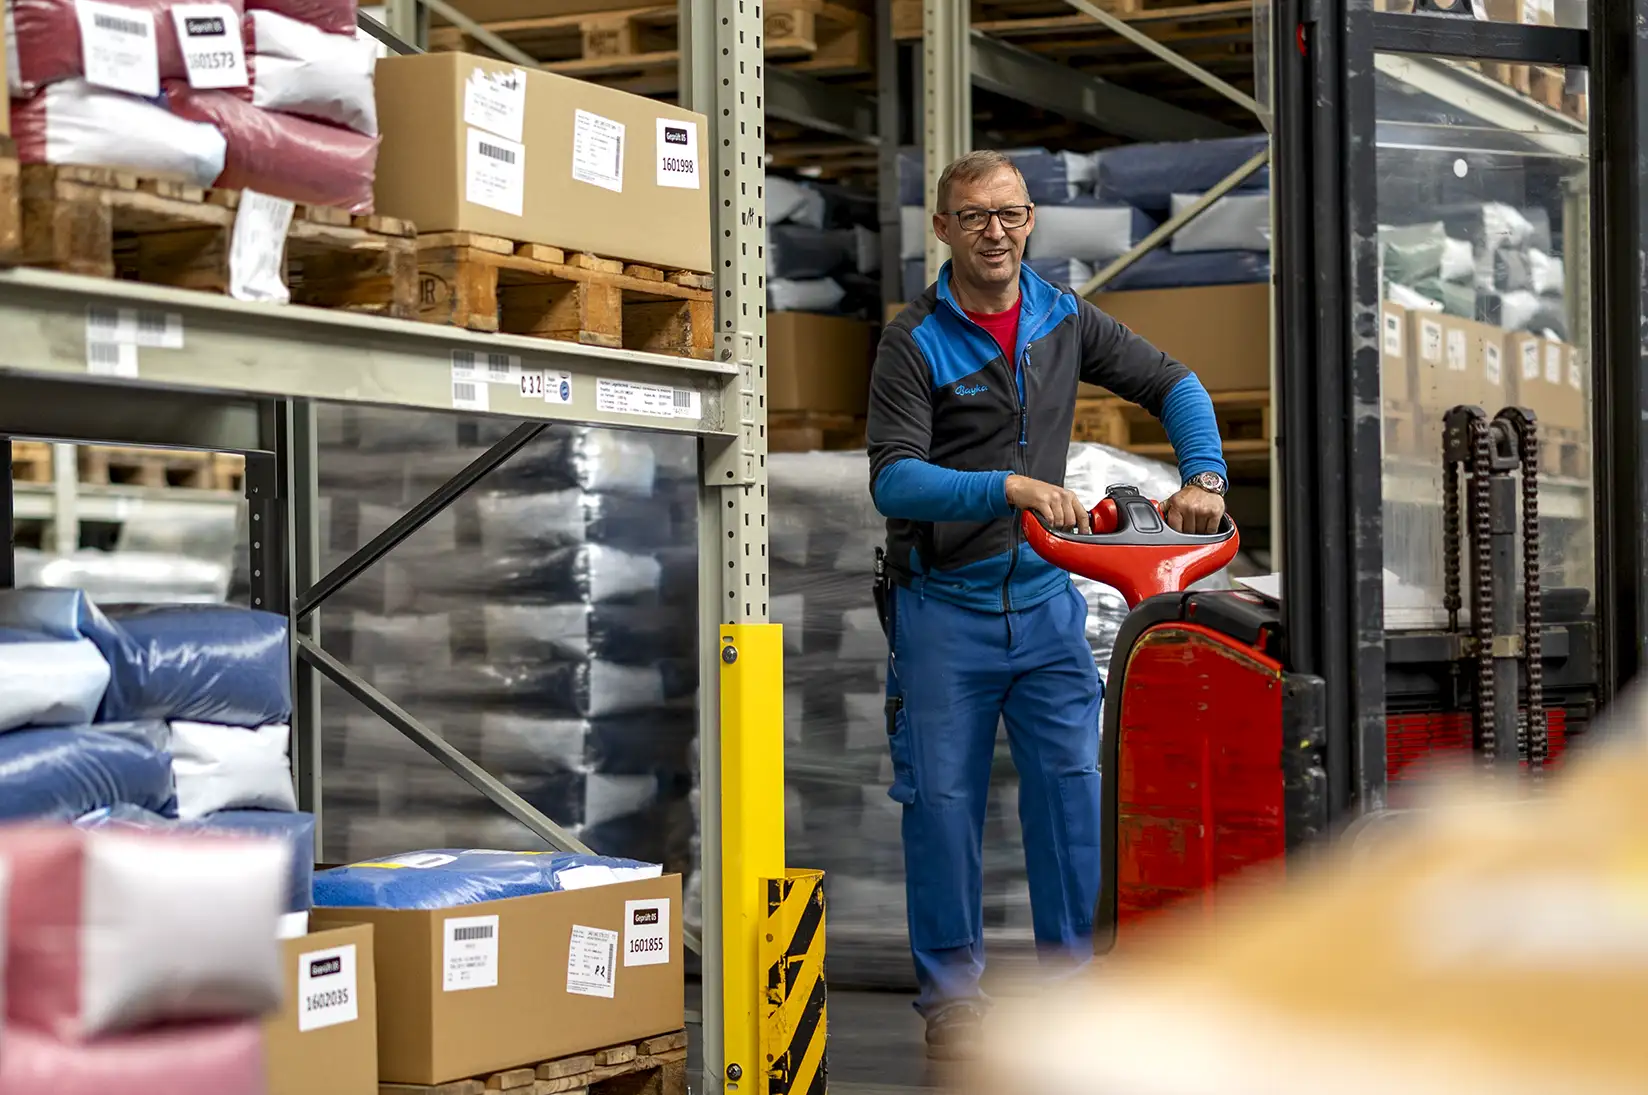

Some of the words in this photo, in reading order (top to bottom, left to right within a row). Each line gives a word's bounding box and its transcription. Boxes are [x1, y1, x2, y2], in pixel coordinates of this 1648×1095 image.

[187, 52, 236, 69] 1601573
[662, 157, 694, 174] 1601998
[954, 383, 989, 396] Bayka
[634, 912, 651, 923] Geprüft
[629, 937, 664, 953] 1601855
[306, 987, 349, 1013] 1602035
